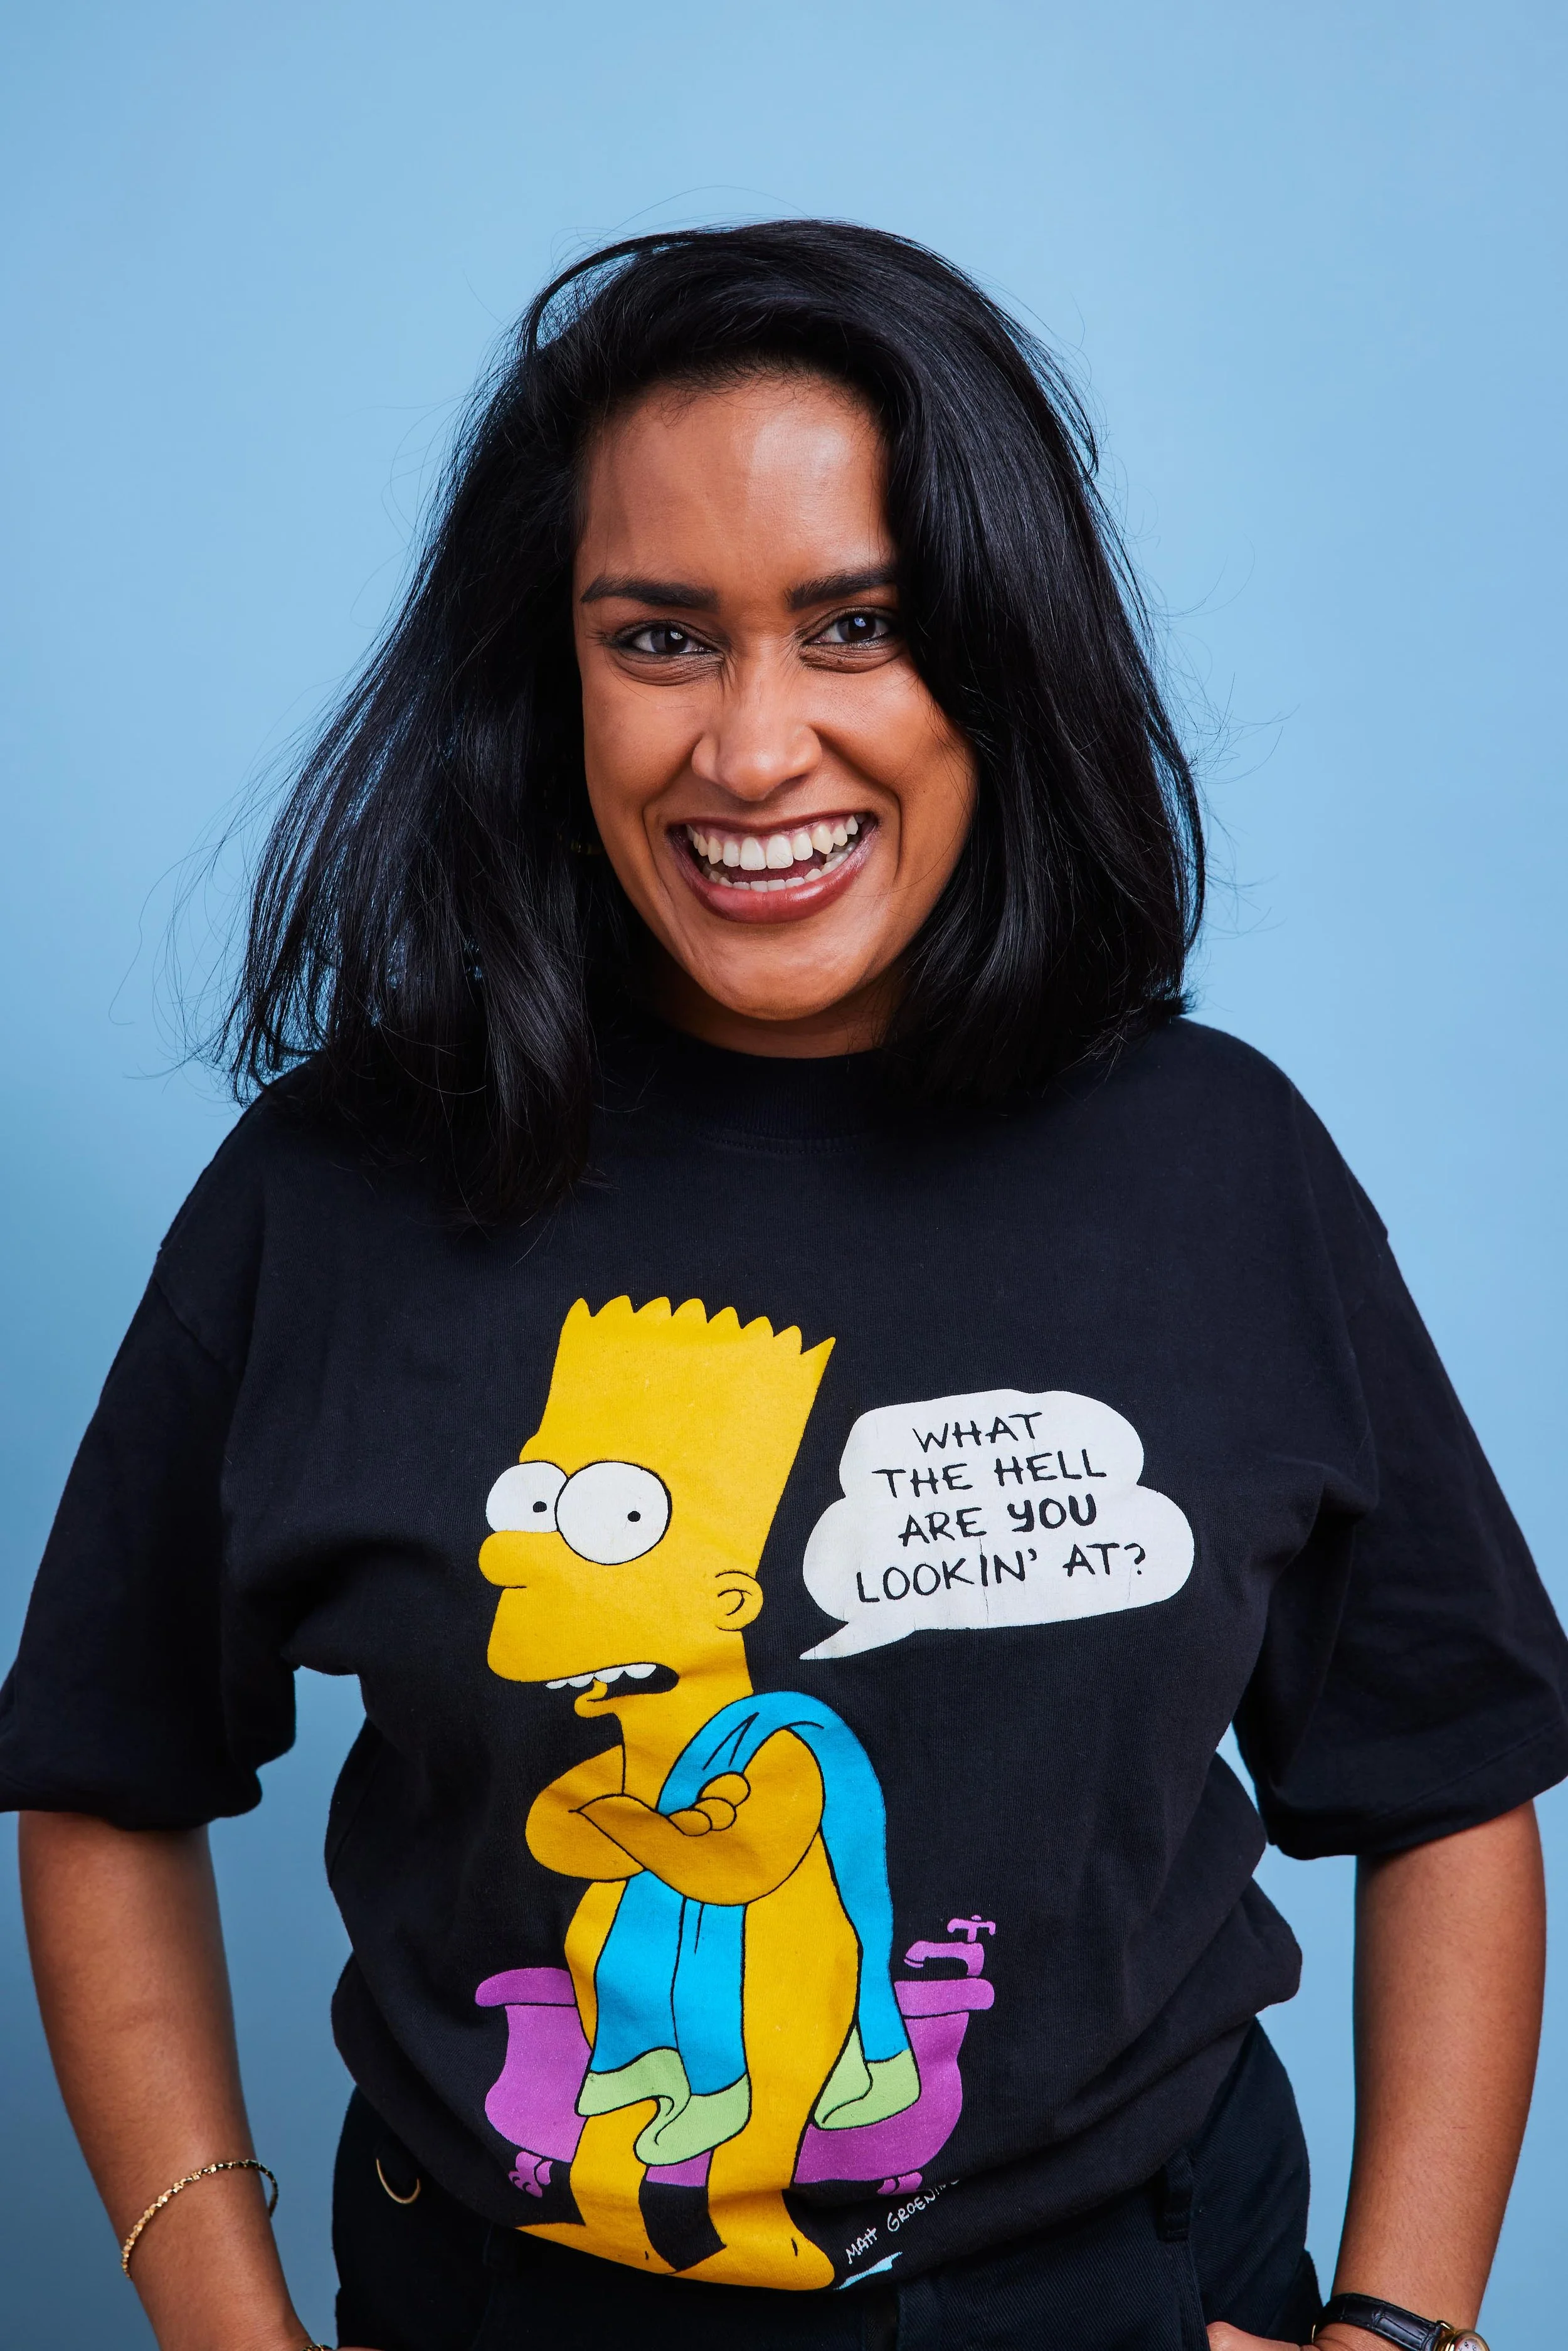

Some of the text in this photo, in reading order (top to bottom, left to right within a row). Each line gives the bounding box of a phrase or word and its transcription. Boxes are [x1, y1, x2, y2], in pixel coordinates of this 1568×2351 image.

[912, 1412, 1042, 1453] WHAT
[872, 1449, 1107, 1498] THE HELL
[898, 1494, 1097, 1546] ARE YOU
[857, 1543, 1146, 1603] LOOKIN' AT?
